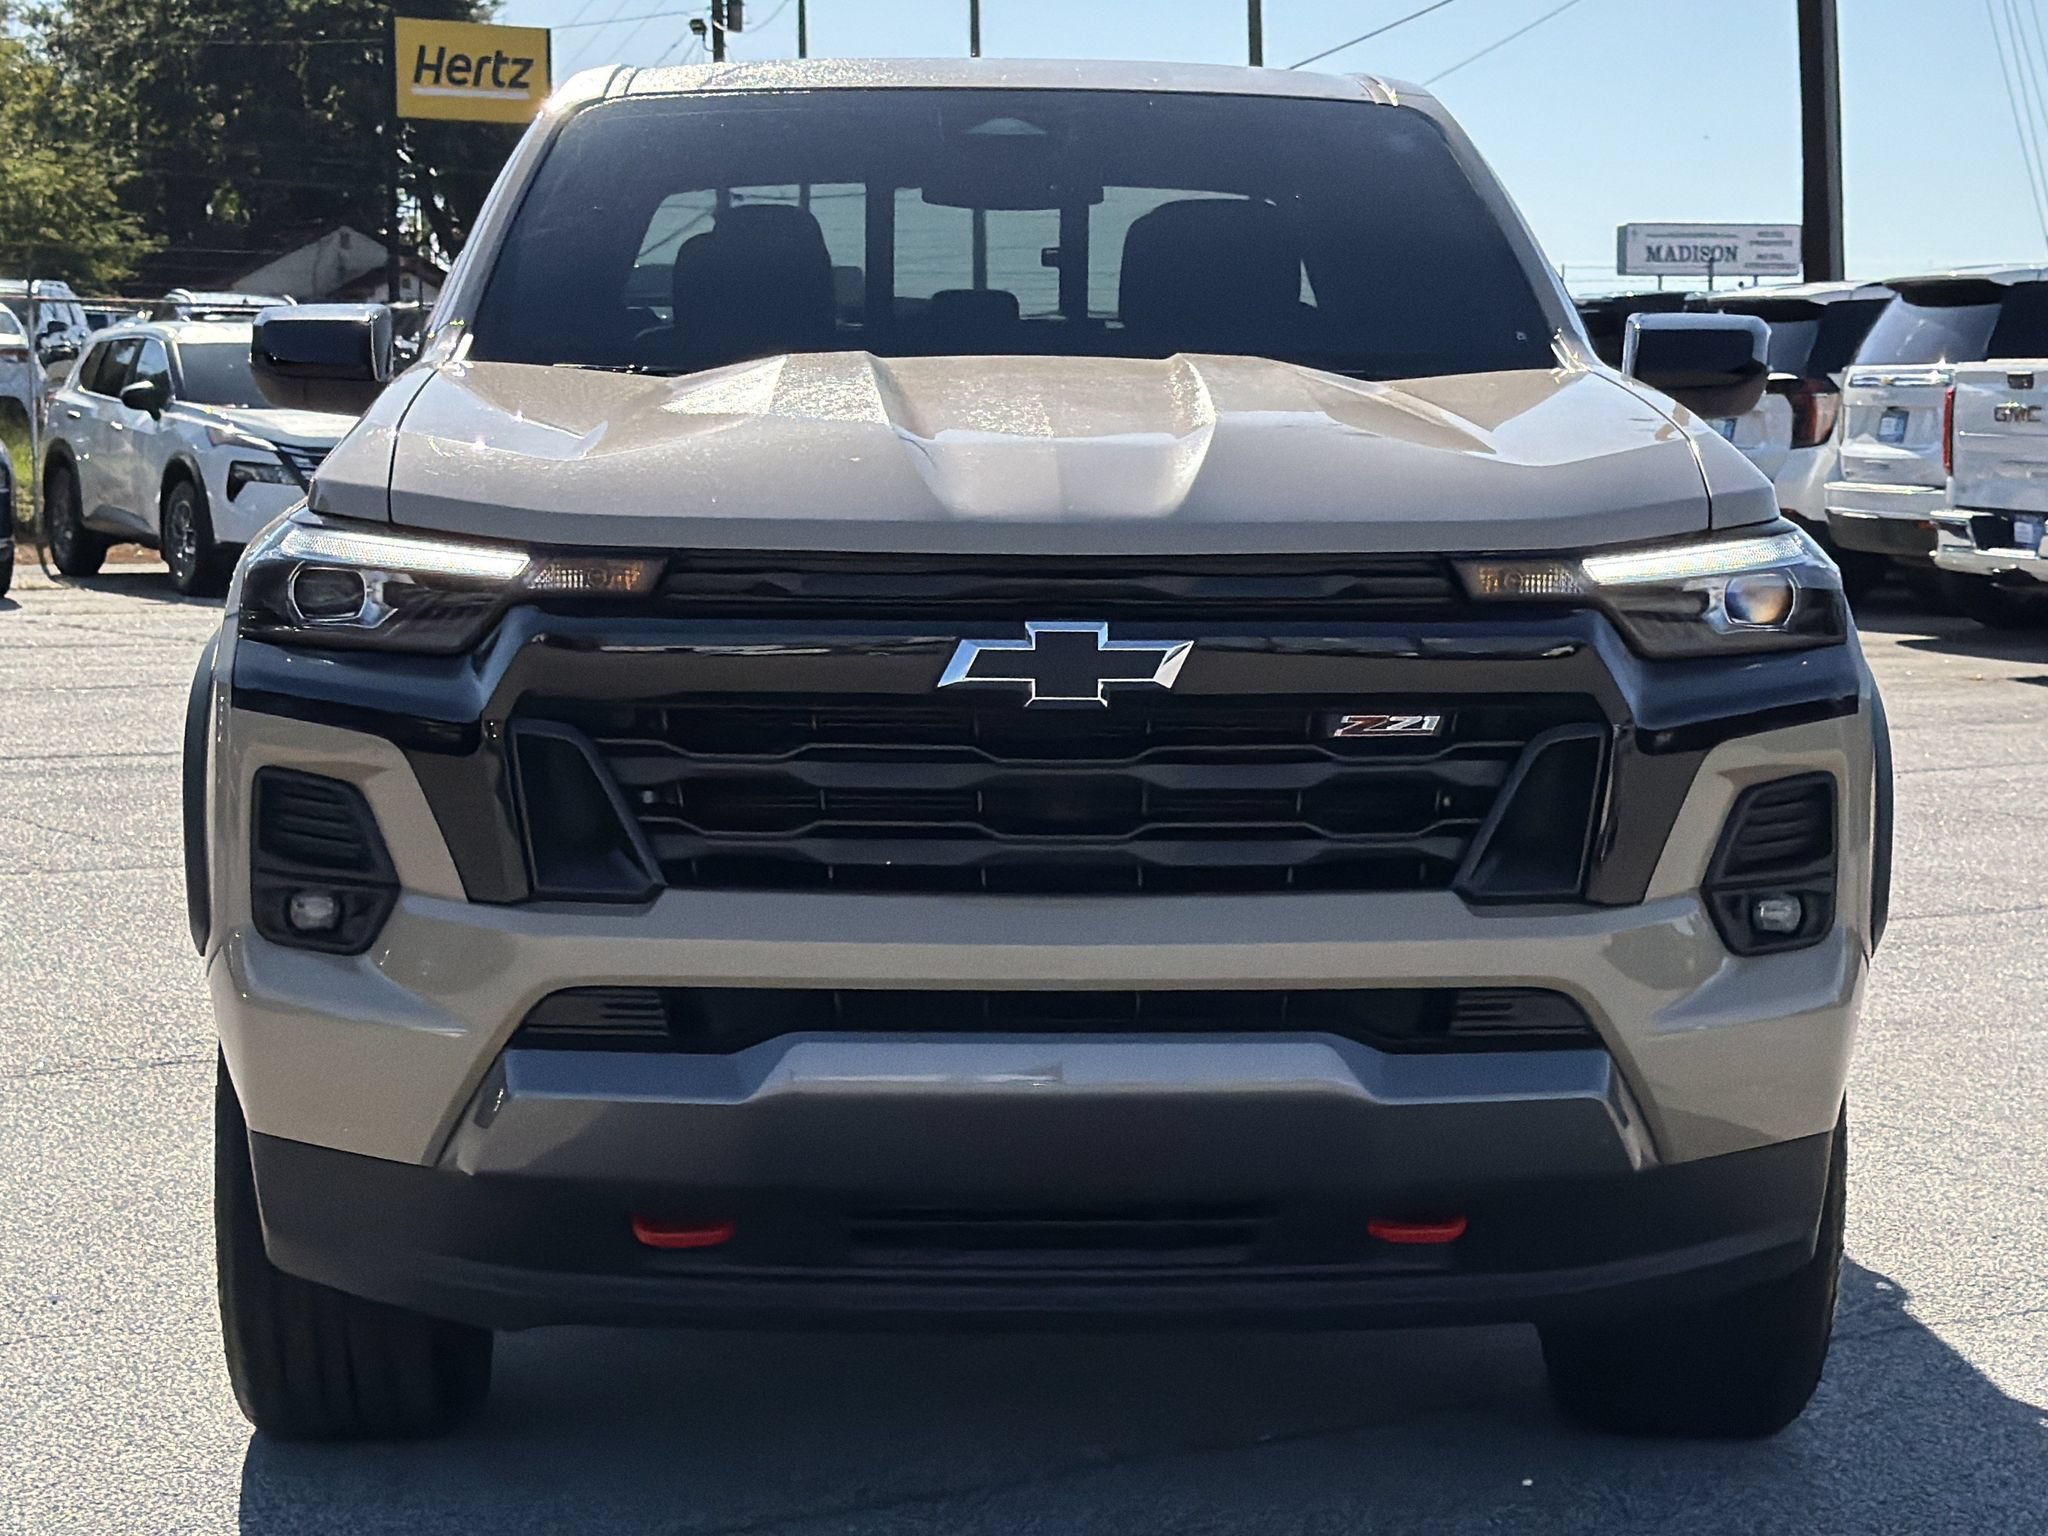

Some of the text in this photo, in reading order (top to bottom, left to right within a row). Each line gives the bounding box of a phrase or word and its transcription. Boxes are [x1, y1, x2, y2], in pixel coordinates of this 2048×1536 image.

[413, 45, 534, 89] Hertz
[1645, 244, 1739, 263] MADISON
[1994, 404, 2042, 422] GMC
[1333, 715, 1440, 737] Z71
